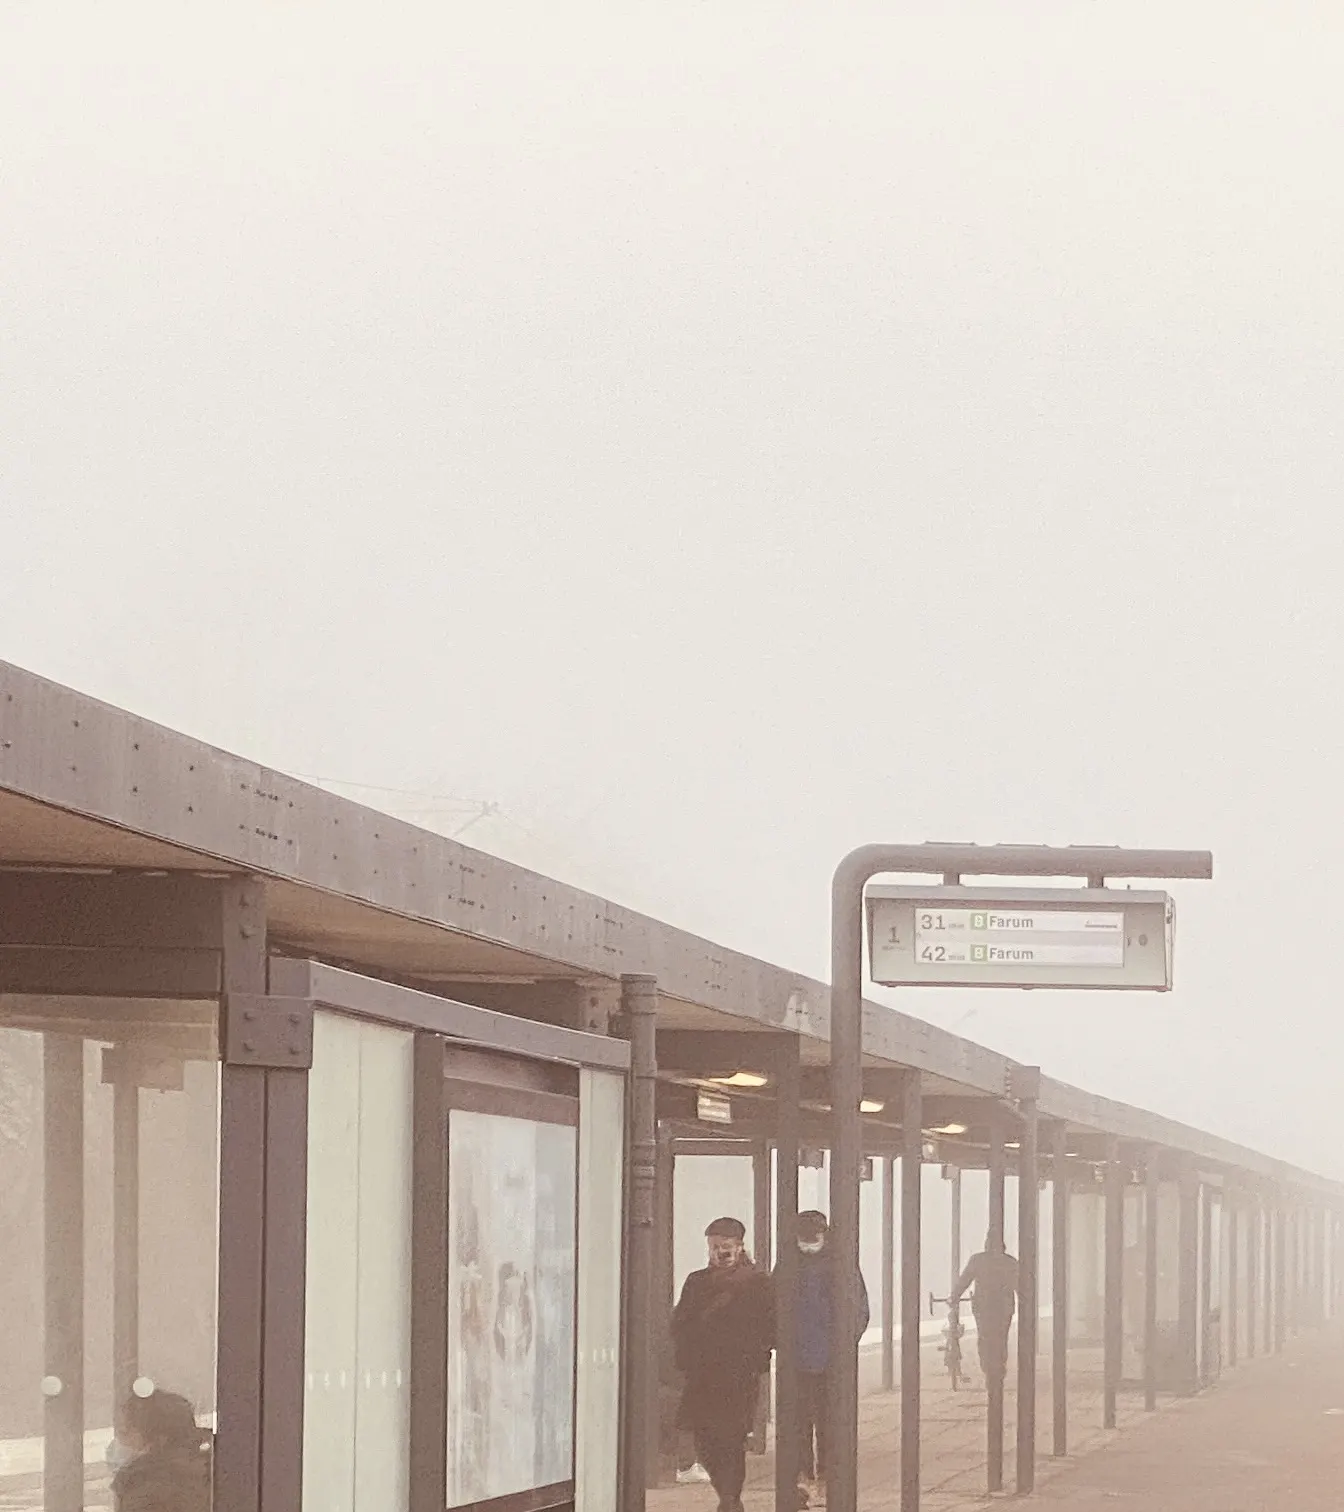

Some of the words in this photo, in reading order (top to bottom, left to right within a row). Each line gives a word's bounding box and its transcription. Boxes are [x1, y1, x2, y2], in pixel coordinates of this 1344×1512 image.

[921, 914, 946, 930] 31
[989, 915, 1034, 929] Farum
[888, 926, 900, 943] 1
[921, 946, 947, 962] 42
[989, 947, 1034, 960] Farum
